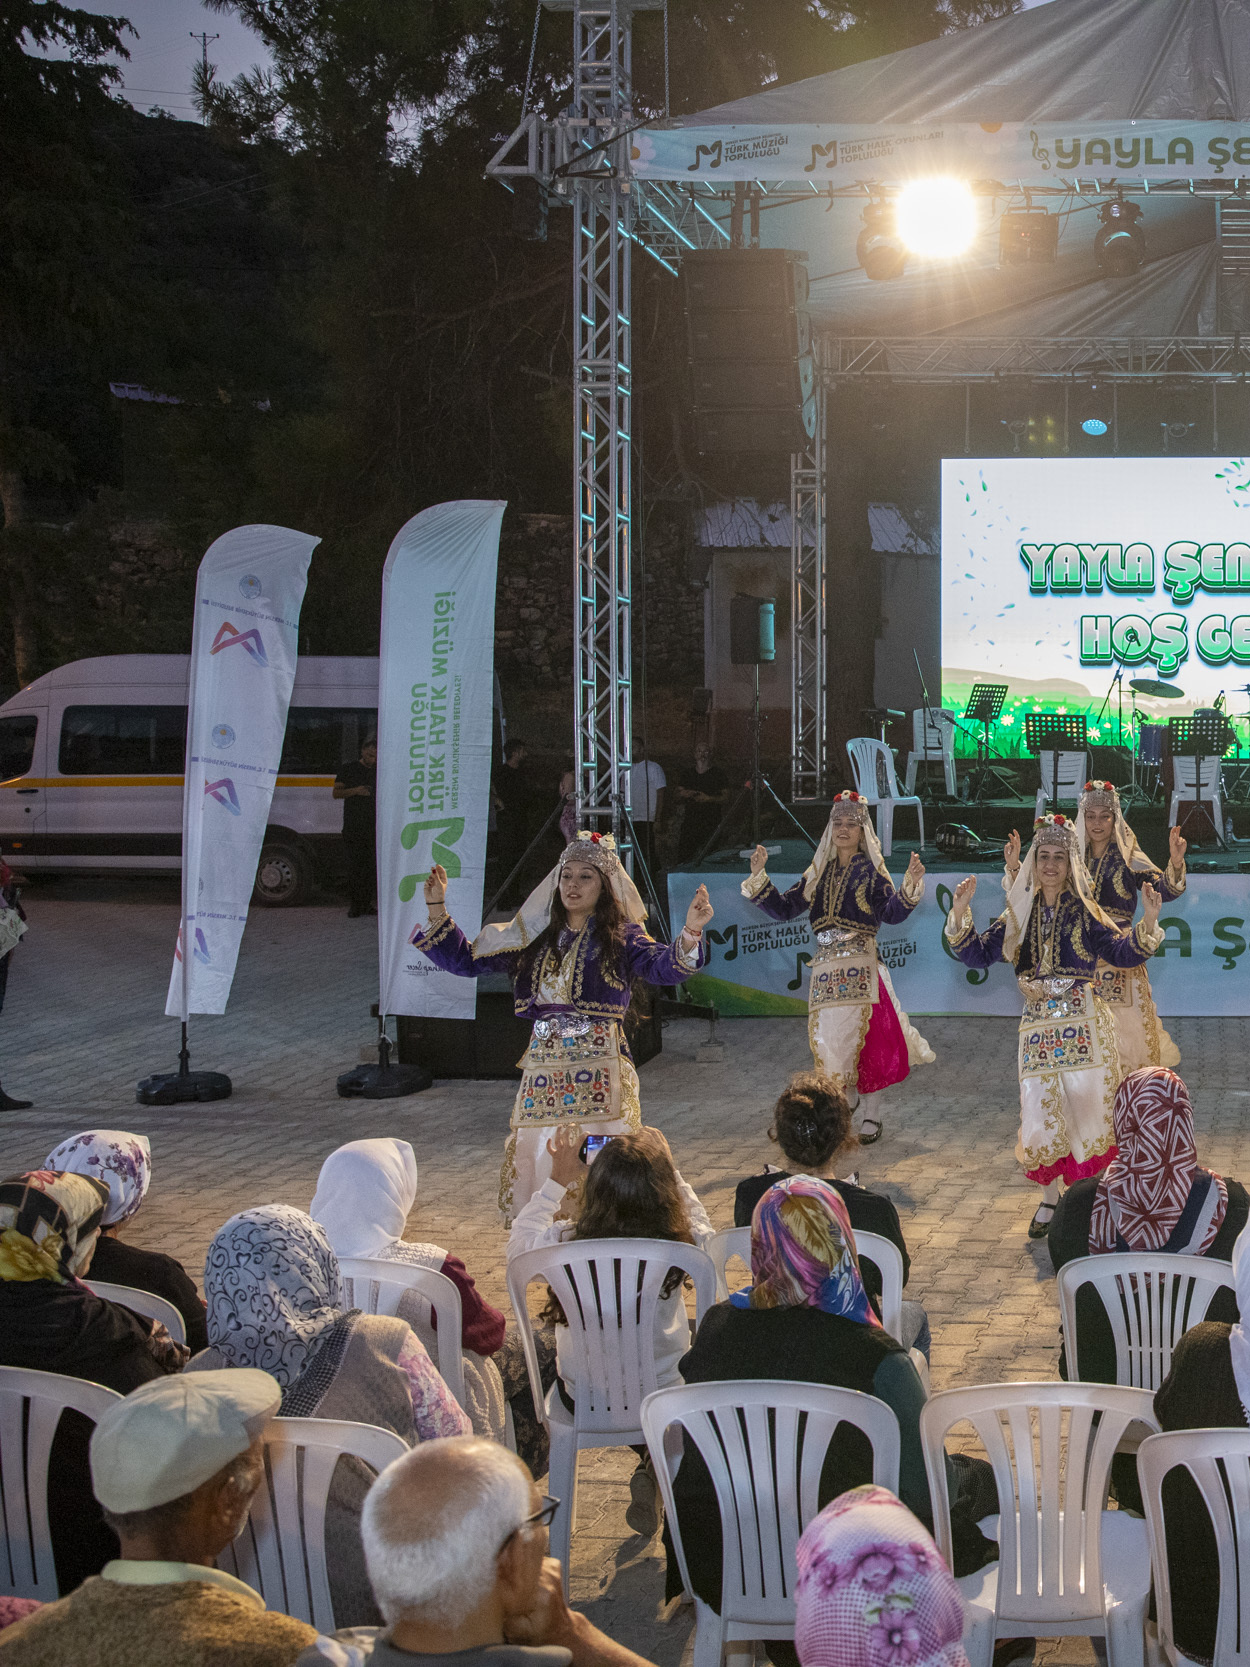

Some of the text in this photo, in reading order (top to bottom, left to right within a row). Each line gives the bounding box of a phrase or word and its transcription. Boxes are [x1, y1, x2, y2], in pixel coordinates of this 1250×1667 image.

[724, 147, 780, 162] TOPLULUĞU
[725, 144, 749, 155] TÜRK
[753, 135, 789, 150] MÜZİĞİ
[840, 143, 864, 155] TÜRK
[867, 139, 892, 151] HALK
[1056, 137, 1194, 169] YAYLA
[1020, 542, 1154, 594] YAYLA
[1080, 612, 1189, 677] HOŞ
[742, 924, 808, 943] TÜRK HALK
[742, 934, 810, 954] TOPLULUĞU
[878, 941, 917, 959] ÜZİĞİ
